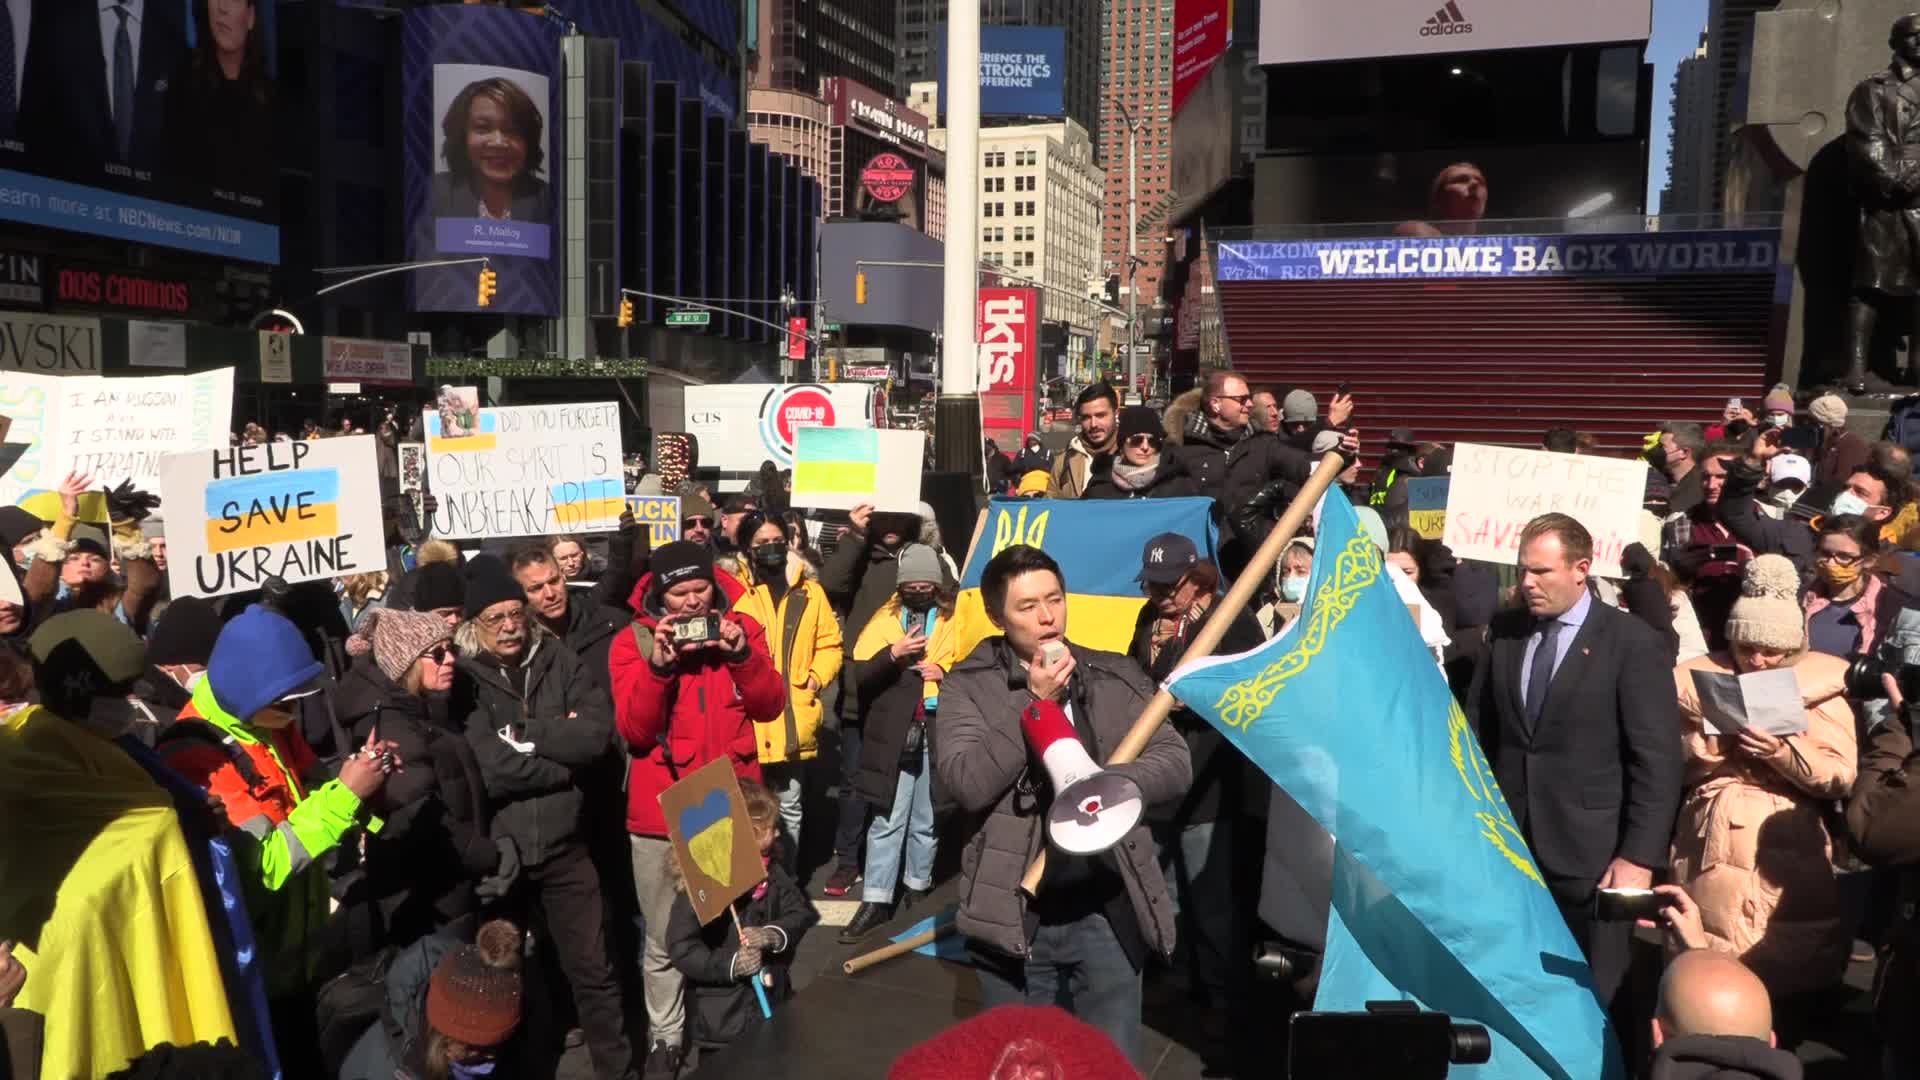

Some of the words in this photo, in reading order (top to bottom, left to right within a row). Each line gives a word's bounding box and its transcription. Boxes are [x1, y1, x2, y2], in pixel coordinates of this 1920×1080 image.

[1419, 22, 1473, 37] adidas
[1025, 54, 1046, 64] THE
[48, 195, 89, 218] more
[94, 206, 113, 223] at
[1319, 247, 1503, 275] WELCOME
[1512, 245, 1617, 273] BACK
[1627, 241, 1774, 270] WORLD
[58, 268, 100, 303] DOS
[104, 275, 190, 313] CAMINOS
[984, 295, 1025, 385] tkts
[528, 409, 556, 432] YOU
[559, 404, 619, 432] FORGET?
[691, 411, 723, 425] CTS
[785, 406, 826, 420] COVID-19
[212, 441, 311, 480] HELP
[437, 452, 498, 487] OUR
[581, 441, 609, 478] IS
[1465, 446, 1553, 481] STOP
[1561, 456, 1634, 496] THE
[219, 490, 319, 533] SAVE
[431, 478, 621, 537] UNBREAKABLE
[631, 500, 676, 520] UCK
[1455, 512, 1528, 551] SAVE
[194, 533, 358, 594] UKRAINE
